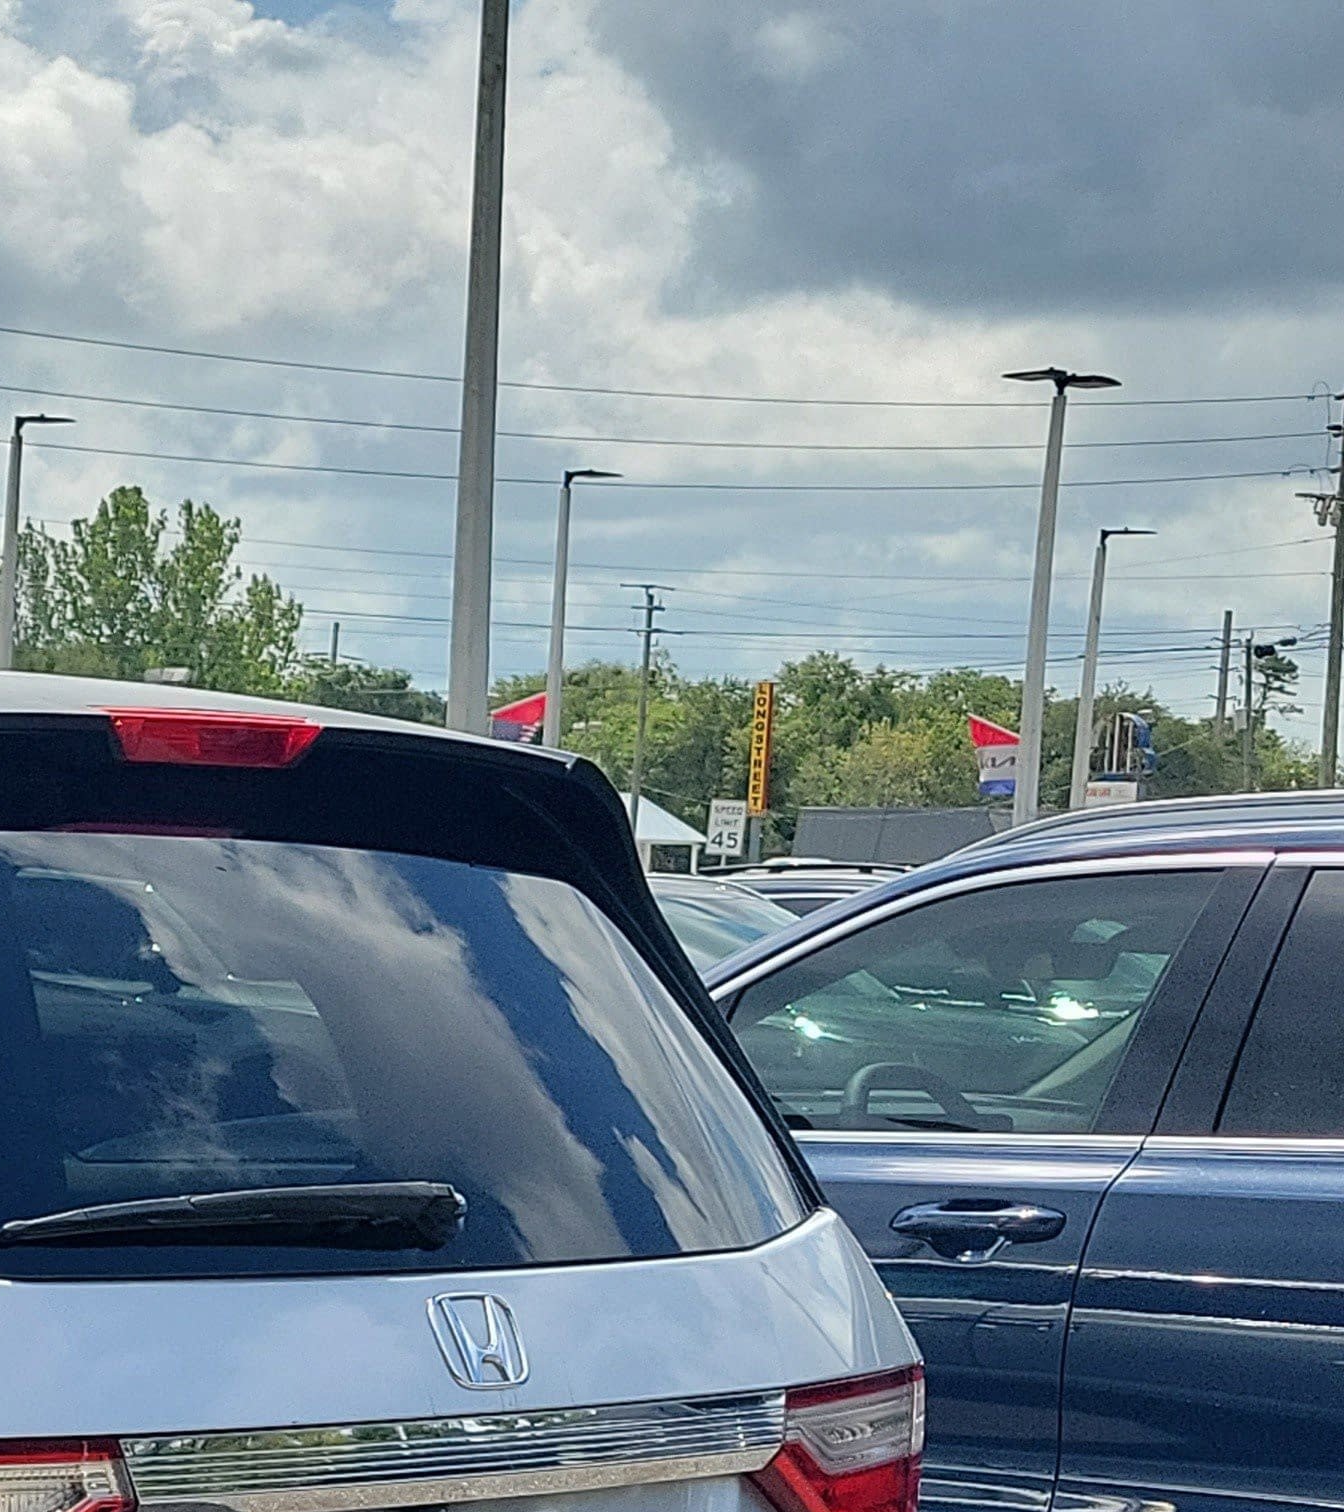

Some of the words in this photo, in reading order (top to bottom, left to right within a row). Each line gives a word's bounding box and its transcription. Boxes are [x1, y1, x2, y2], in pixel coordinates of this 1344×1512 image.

[751, 682, 768, 807] LONGSTREET
[714, 805, 744, 816] SPEED
[714, 818, 739, 827] LIMIT
[712, 831, 739, 849] 45
